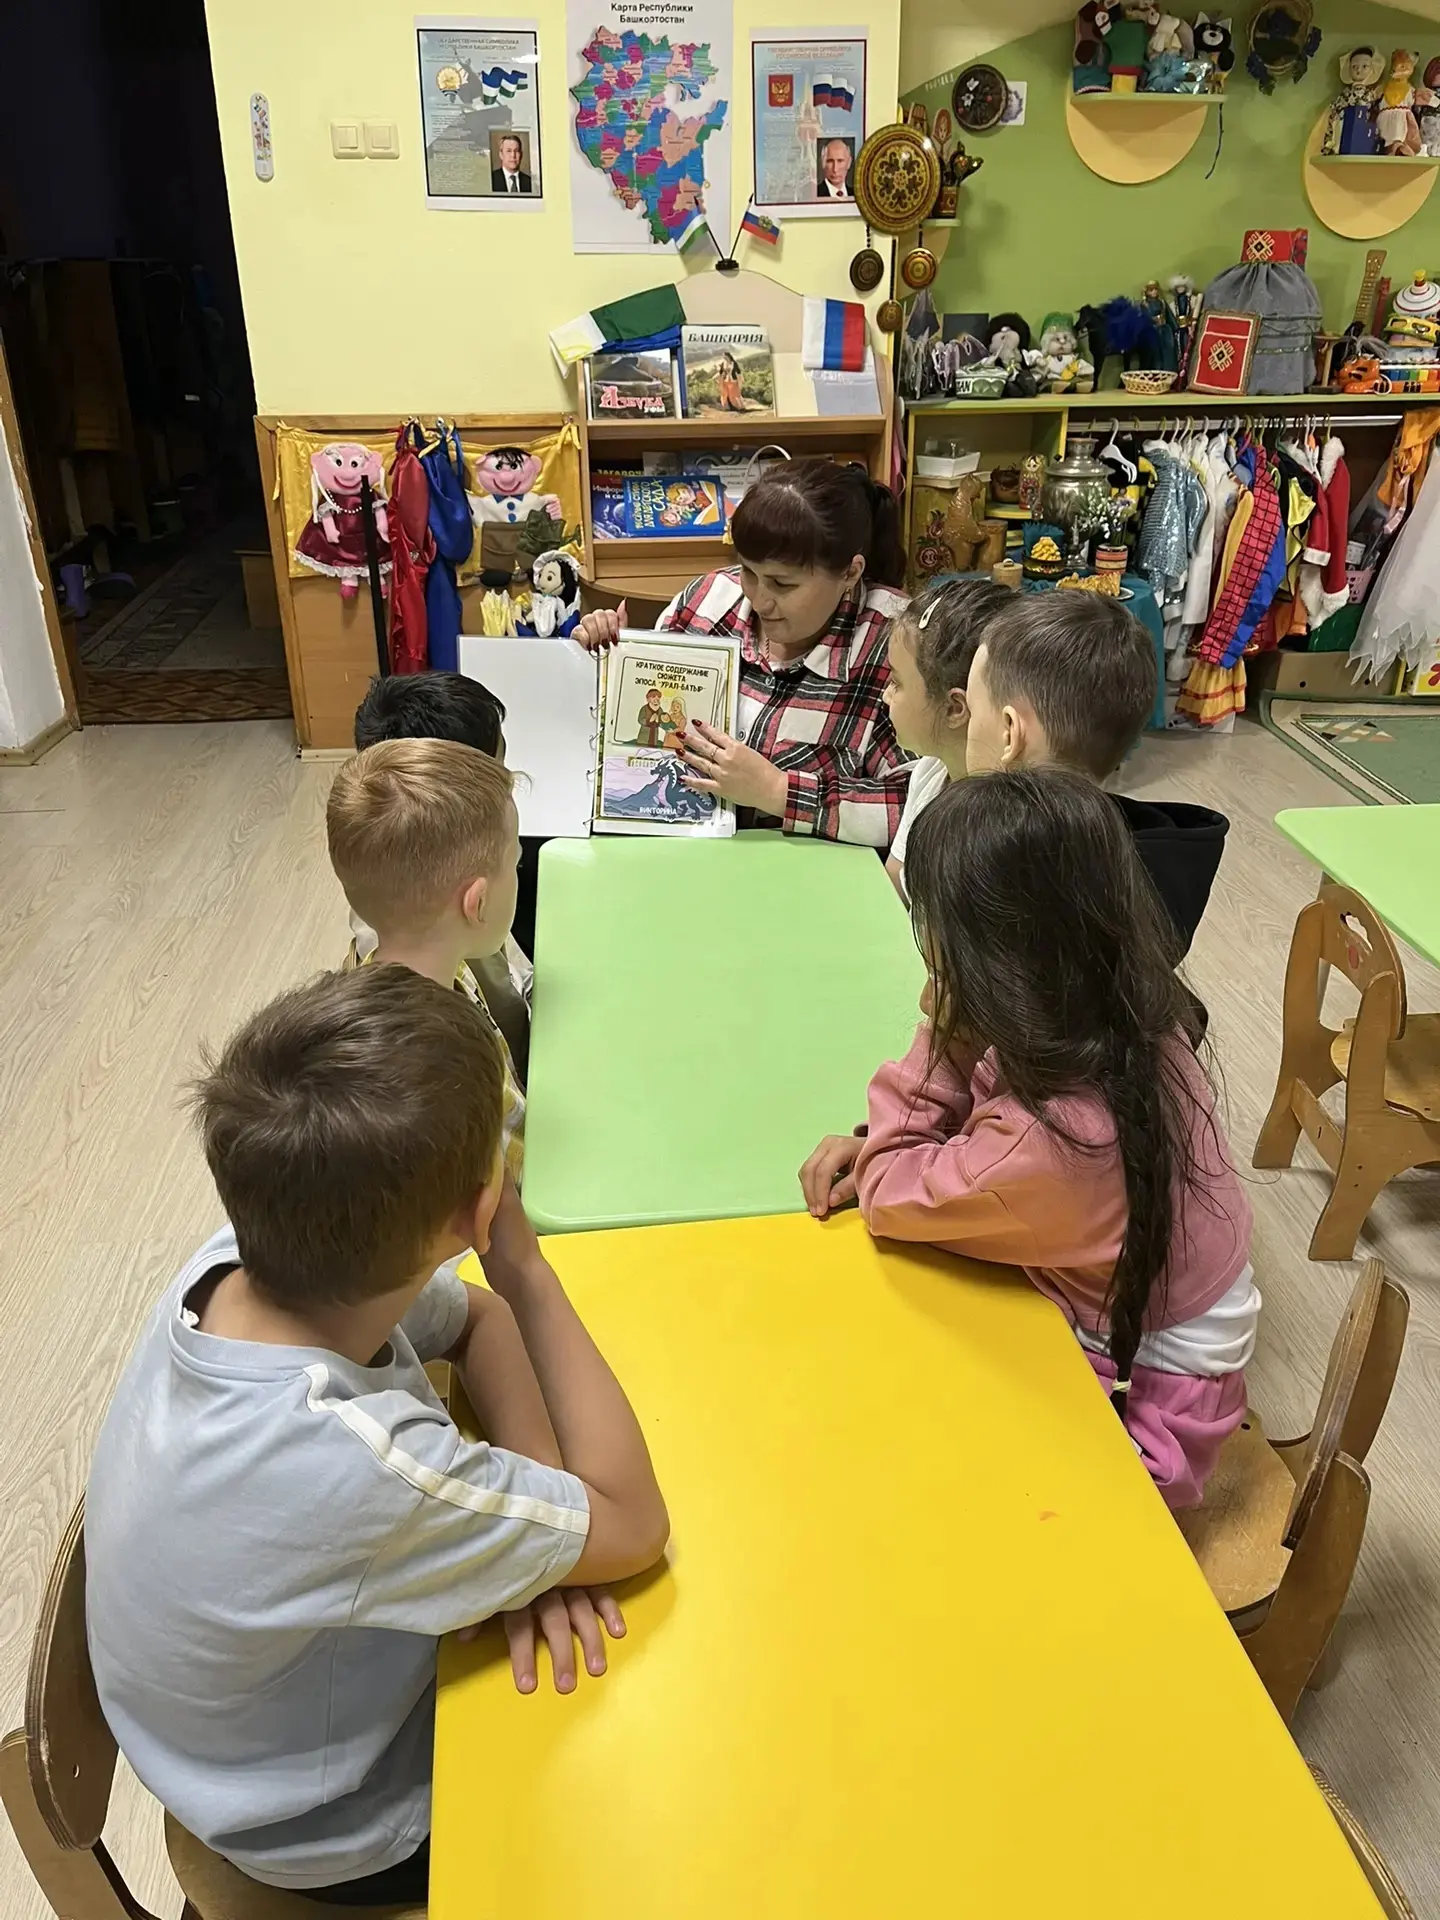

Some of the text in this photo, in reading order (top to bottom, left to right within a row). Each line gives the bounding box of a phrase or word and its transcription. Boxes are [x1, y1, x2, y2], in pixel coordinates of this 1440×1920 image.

[611, 3, 693, 13] Карта Республики
[620, 15, 684, 23] Башкортостан
[688, 333, 763, 343] БАШКИРИЯ
[651, 479, 666, 511] САДА
[635, 661, 709, 677] КРАТКОЕ СОДЕРЖАНИЕ
[635, 677, 656, 687] ЭПОСА
[657, 672, 686, 682] СЮЖЕТА
[640, 806, 677, 815] ВИКТОРИНА
